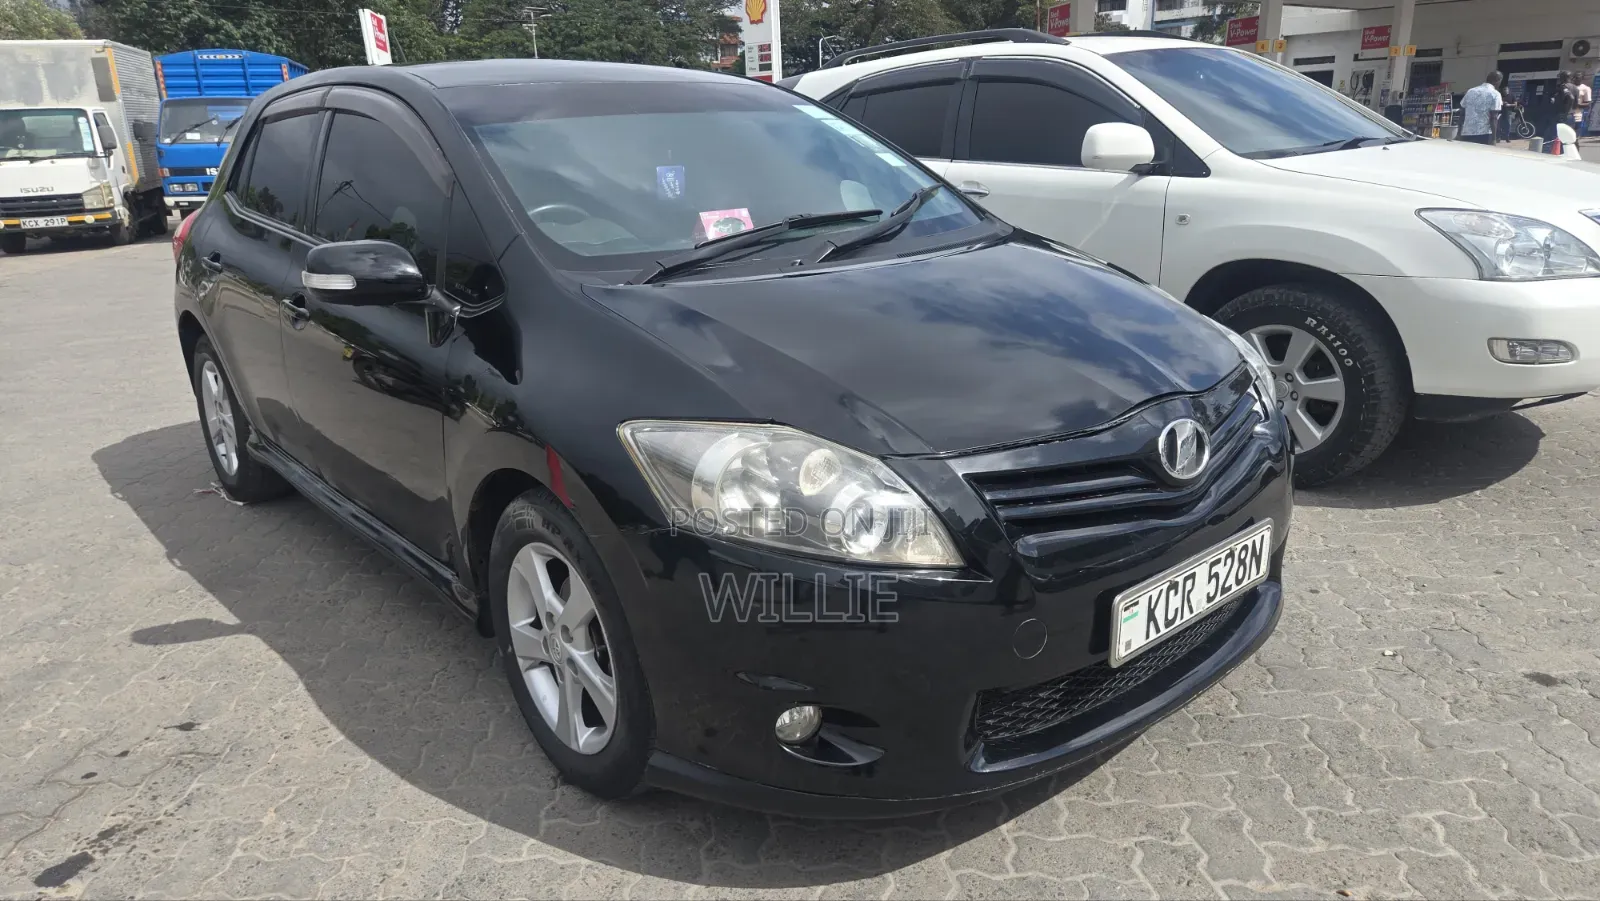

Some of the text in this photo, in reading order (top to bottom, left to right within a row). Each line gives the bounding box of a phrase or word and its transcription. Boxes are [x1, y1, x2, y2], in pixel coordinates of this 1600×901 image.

[1050, 17, 1070, 29] V-Powe
[1230, 28, 1257, 37] V-Power
[1364, 35, 1389, 43] V-Power
[20, 186, 54, 194] ISUZU
[21, 217, 66, 228] KCX 291P
[1145, 534, 1265, 641] KCR 528N
